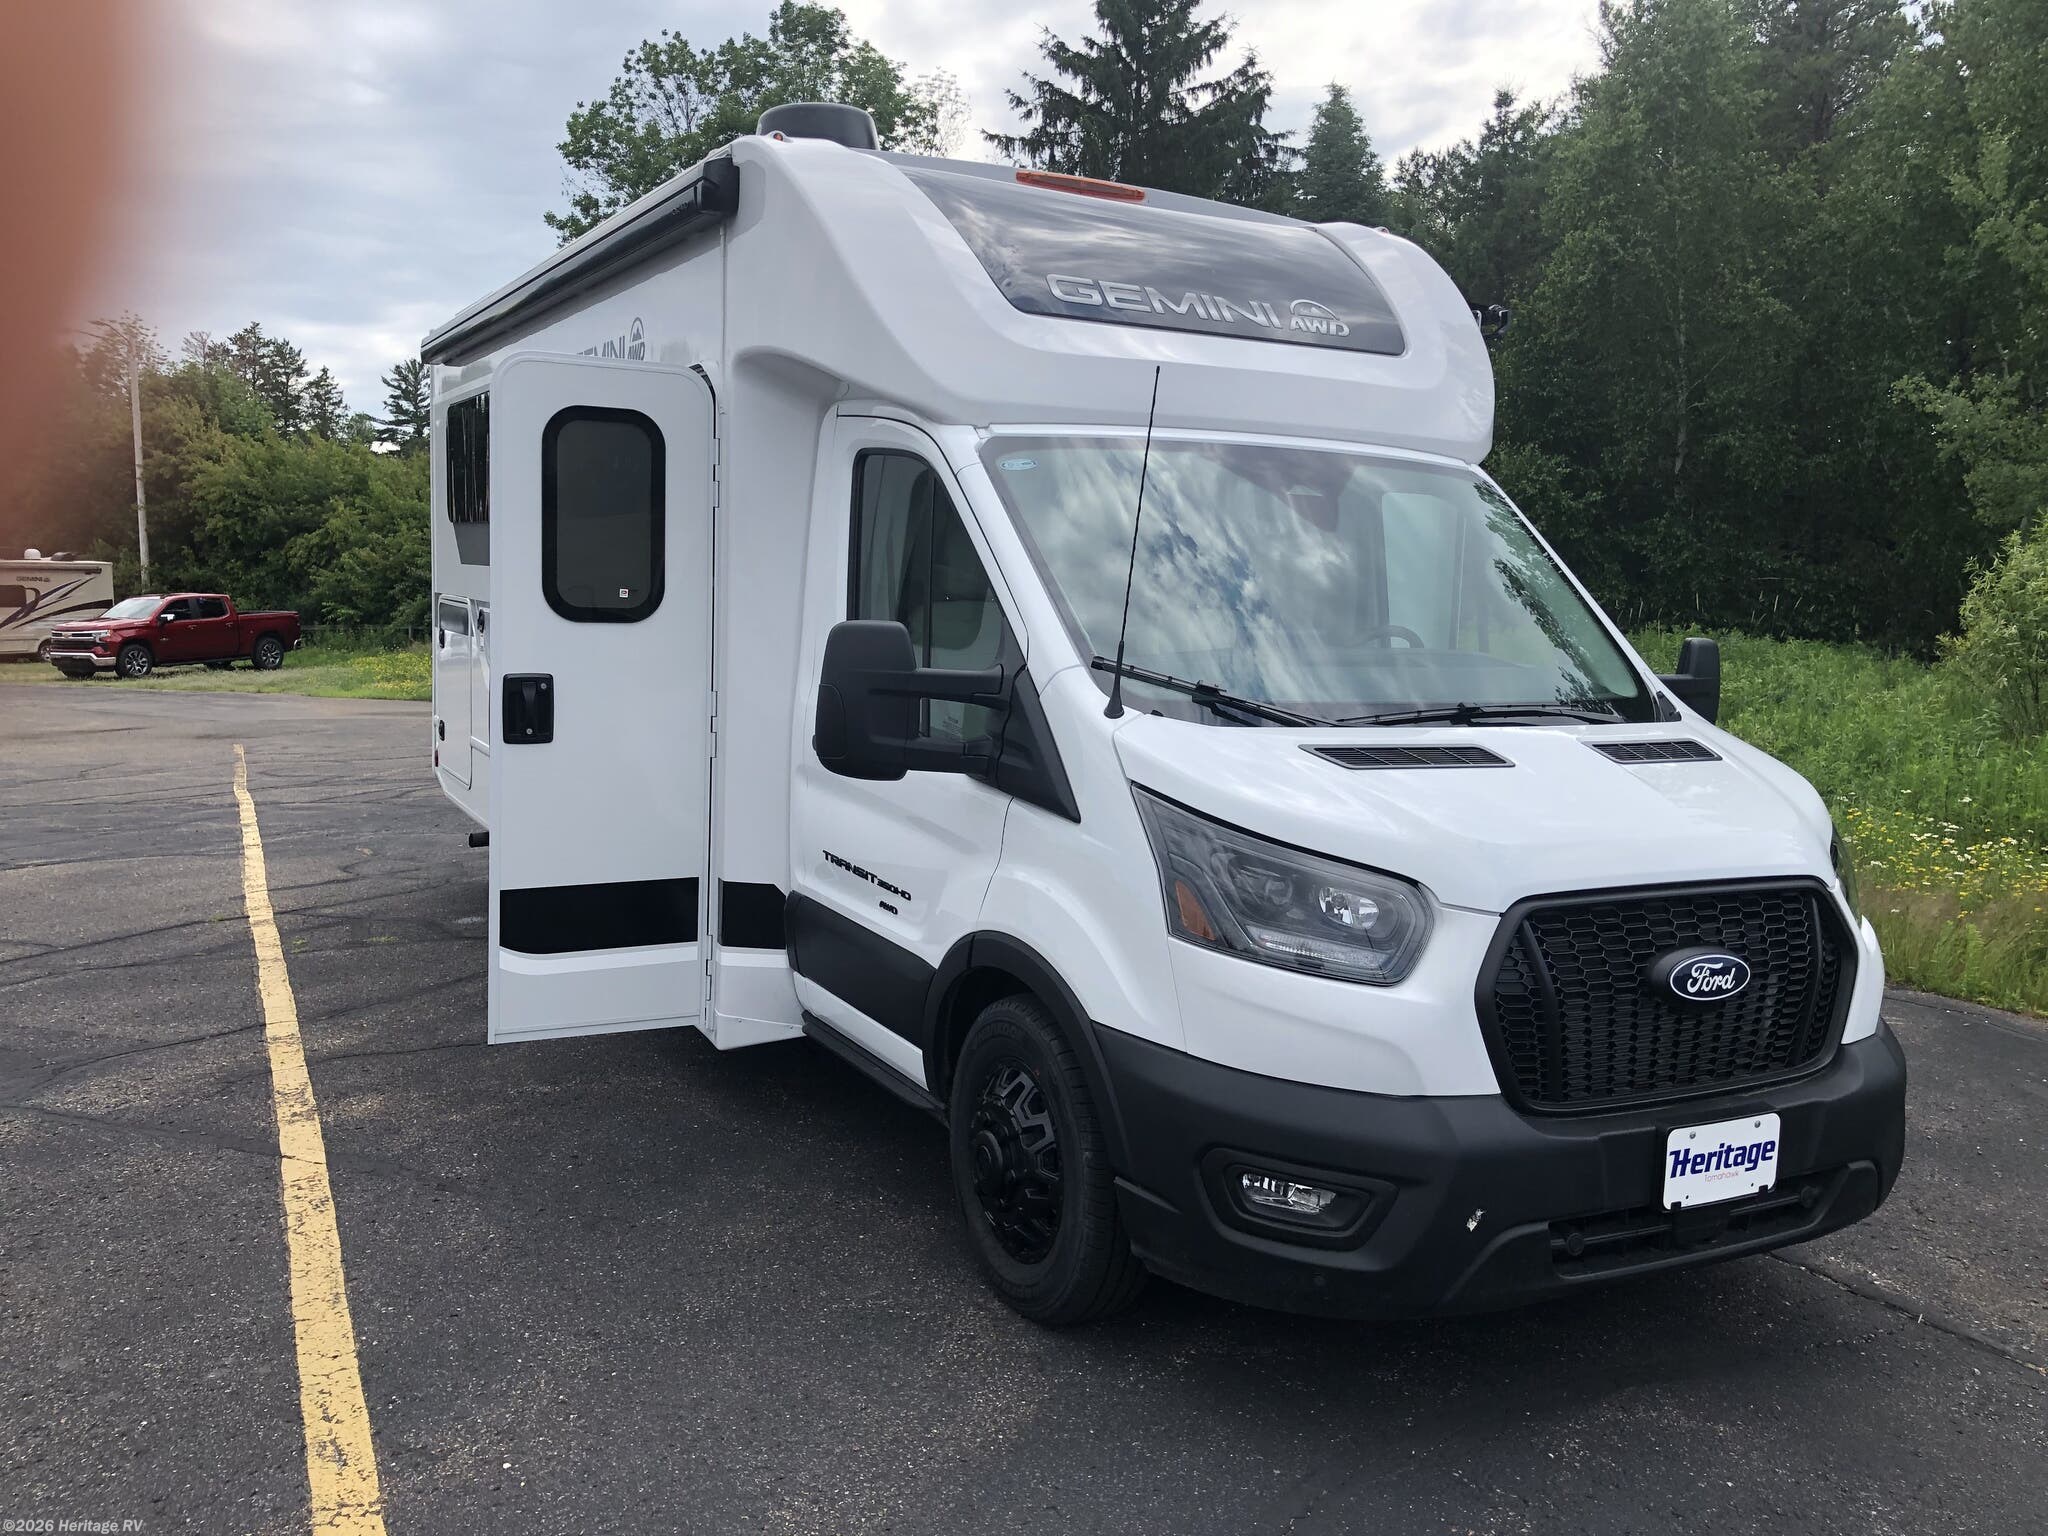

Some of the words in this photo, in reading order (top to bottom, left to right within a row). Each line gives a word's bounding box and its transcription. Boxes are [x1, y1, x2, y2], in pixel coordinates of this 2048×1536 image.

[1045, 272, 1283, 329] GEMINI
[1289, 316, 1351, 338] AWD
[822, 849, 878, 884] TRANSIT
[1686, 962, 1737, 993] Ford
[1669, 1140, 1776, 1179] Heritage
